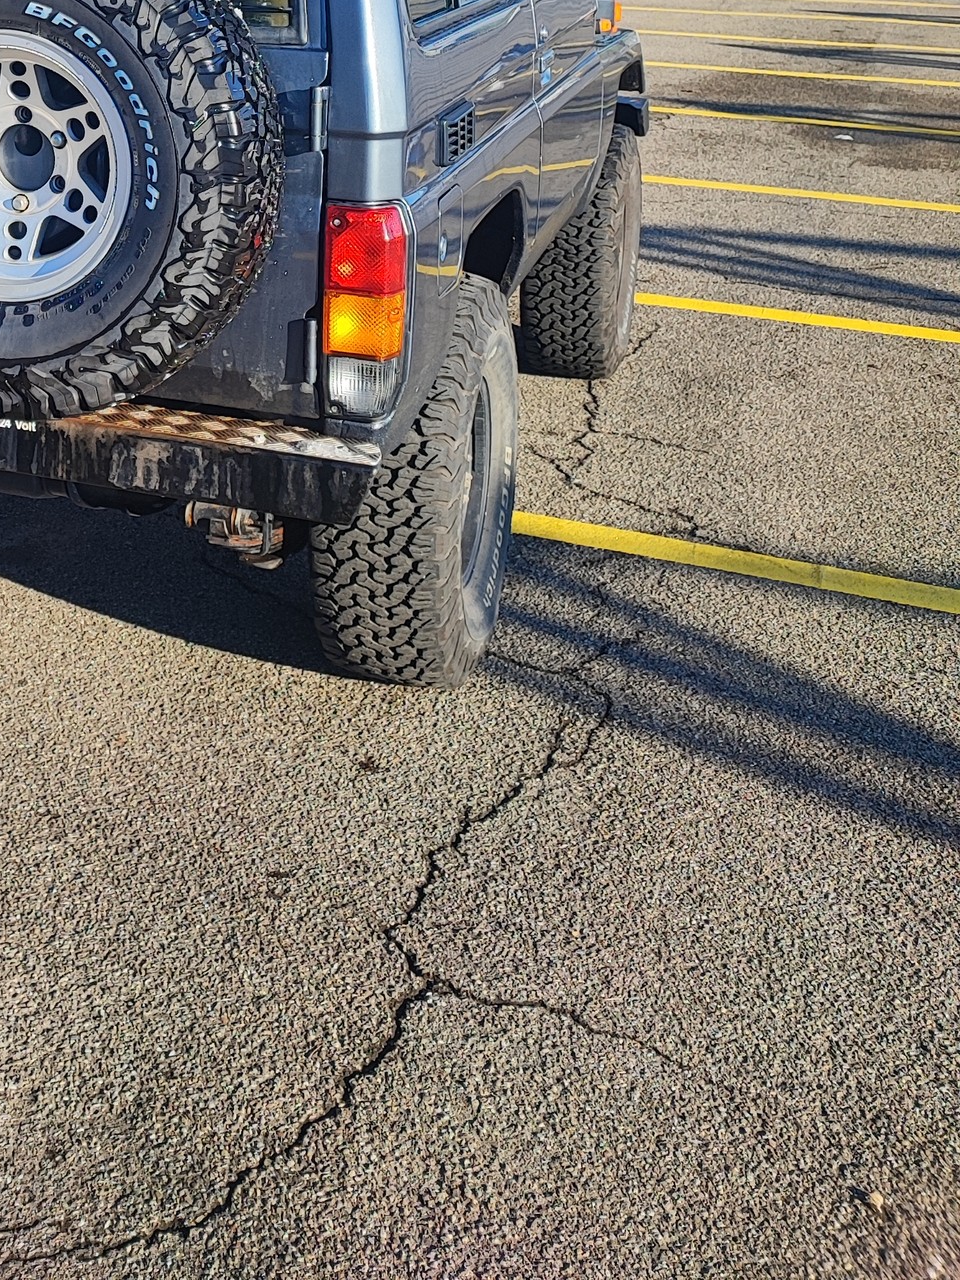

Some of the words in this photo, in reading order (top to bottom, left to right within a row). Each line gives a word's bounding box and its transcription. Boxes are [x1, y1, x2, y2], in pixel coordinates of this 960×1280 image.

[24, 1, 160, 211] BFGoodrich
[14, 420, 37, 432] Volt
[482, 446, 513, 608] BFGoodrich
